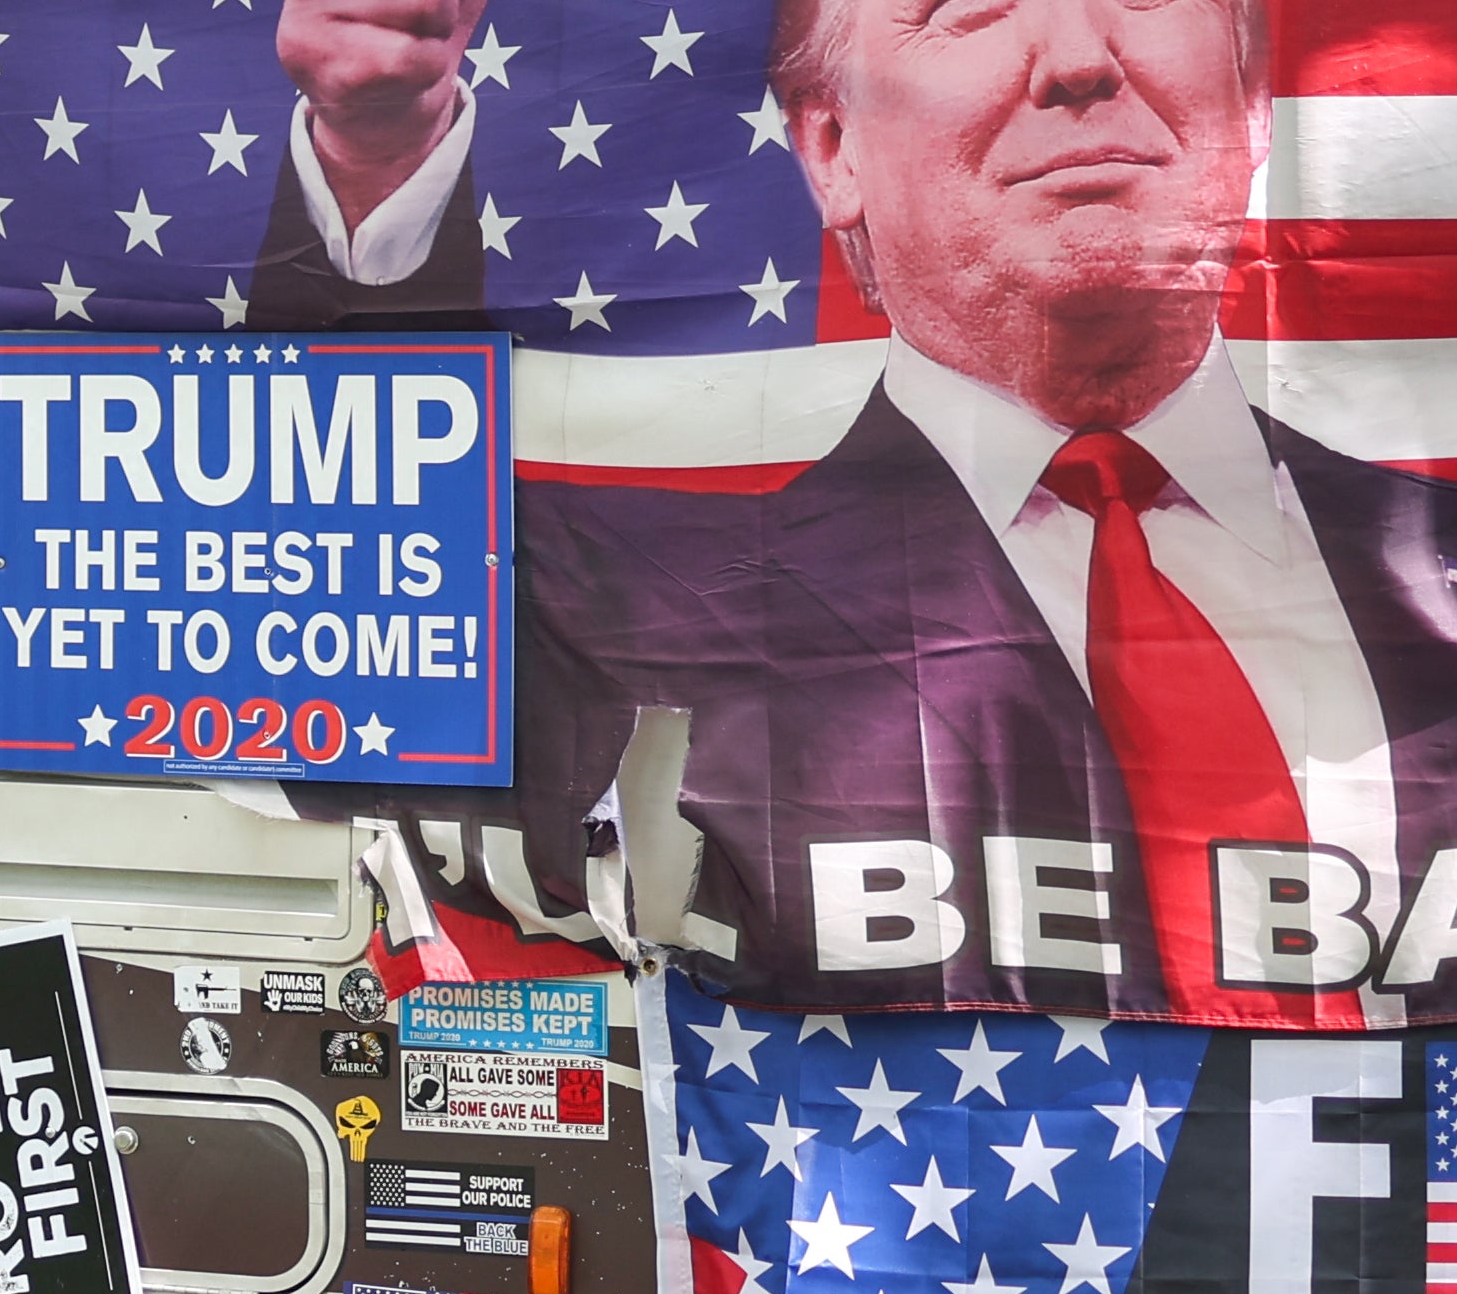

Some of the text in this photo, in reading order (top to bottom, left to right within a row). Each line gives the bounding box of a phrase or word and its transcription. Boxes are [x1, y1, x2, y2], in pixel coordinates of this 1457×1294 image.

[35, 529, 442, 597] THE BEST IS
[3, 607, 479, 679] YET TO COME!
[124, 696, 347, 762] 2020
[807, 836, 1123, 974] BE
[264, 974, 323, 991] UNMASK
[284, 992, 323, 1004] OUR KIDS
[408, 986, 523, 1009] PROMISES
[530, 992, 594, 1012] MADE
[412, 1009, 592, 1035] PROMISES KEPT
[405, 1053, 604, 1069] AMERICA REMEMBERS
[449, 1067, 473, 1083] ALL
[478, 1069, 512, 1084] GAVE
[518, 1070, 554, 1086] SOME
[449, 1102, 554, 1120] SOME GAVE ALL
[470, 1176, 523, 1192] SUPPORT
[463, 1192, 531, 1208] OUR POLICE
[477, 1222, 516, 1238] BACK
[464, 1237, 529, 1255] THE BLUE
